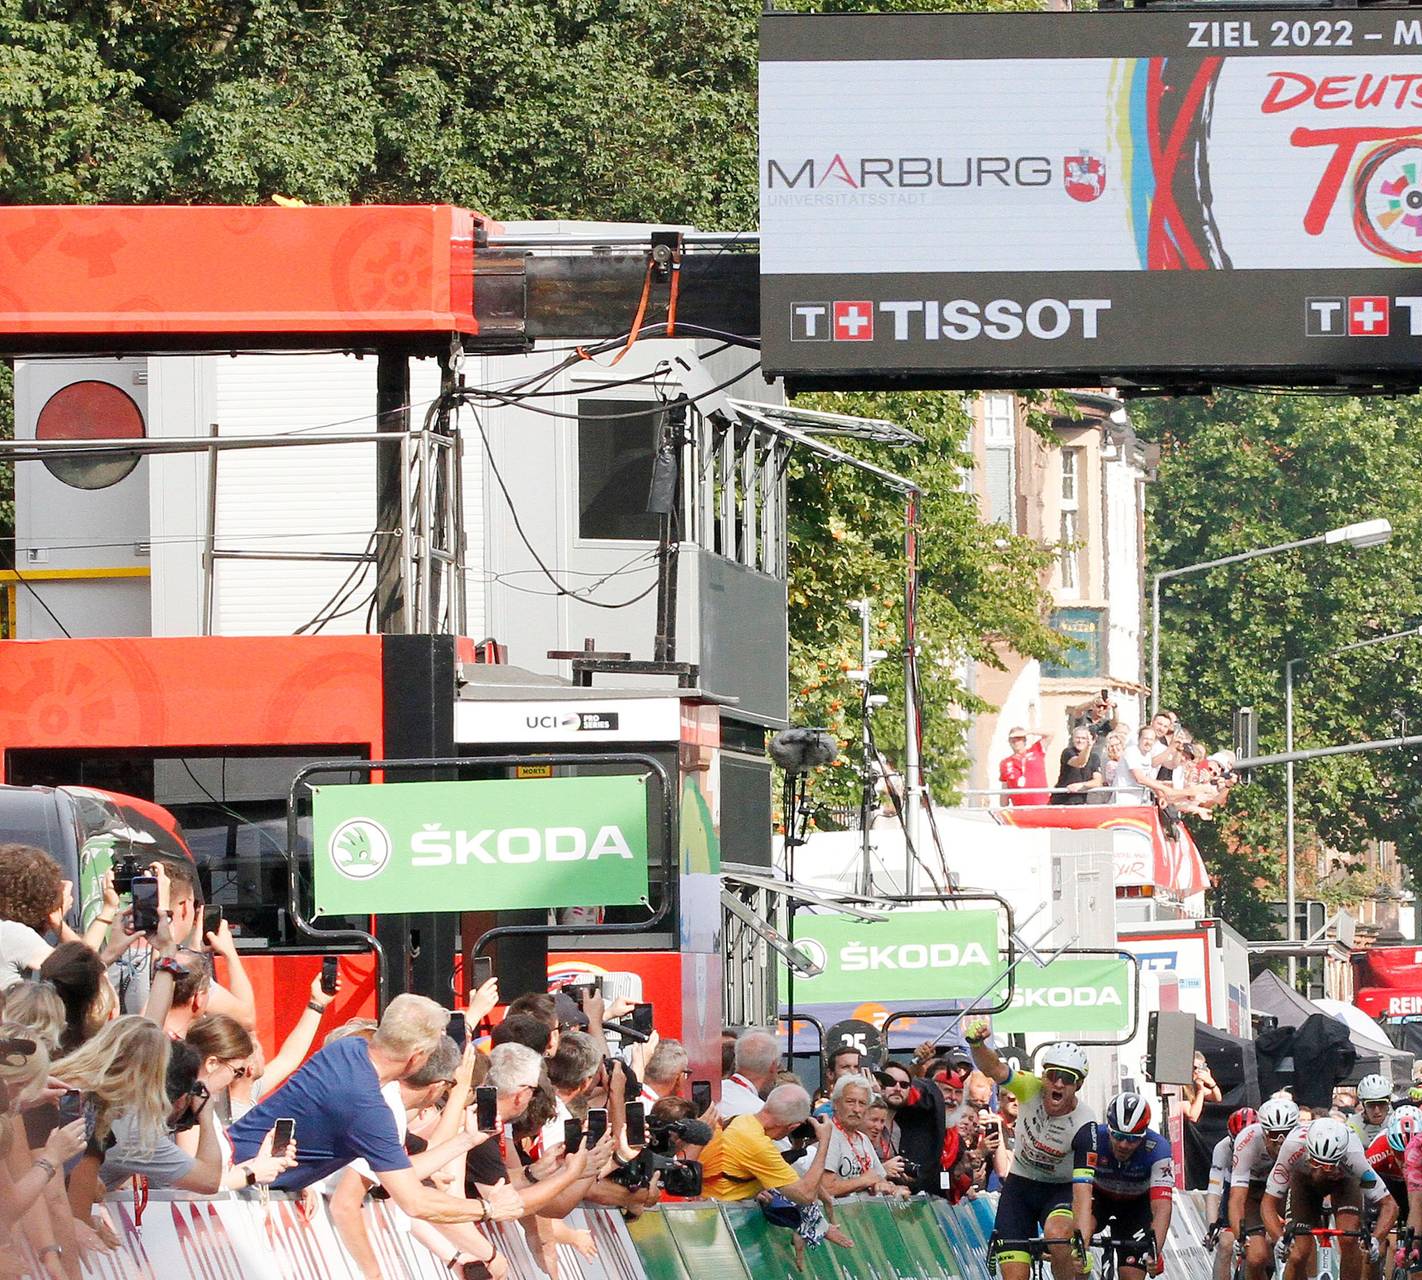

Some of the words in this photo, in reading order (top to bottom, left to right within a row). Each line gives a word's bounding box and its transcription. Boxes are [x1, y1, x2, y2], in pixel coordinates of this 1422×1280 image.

[1188, 21, 1259, 48] ZIEL
[1270, 20, 1353, 47] 2022
[768, 153, 1052, 189] MARBURG
[880, 298, 1111, 341] TISSOT
[526, 716, 557, 728] UCI
[583, 714, 599, 722] PRO
[583, 720, 610, 729] SERIES
[411, 823, 634, 867] ŠKODA
[840, 941, 991, 972] ŠKODA
[1001, 985, 1122, 1008] ŠKODA
